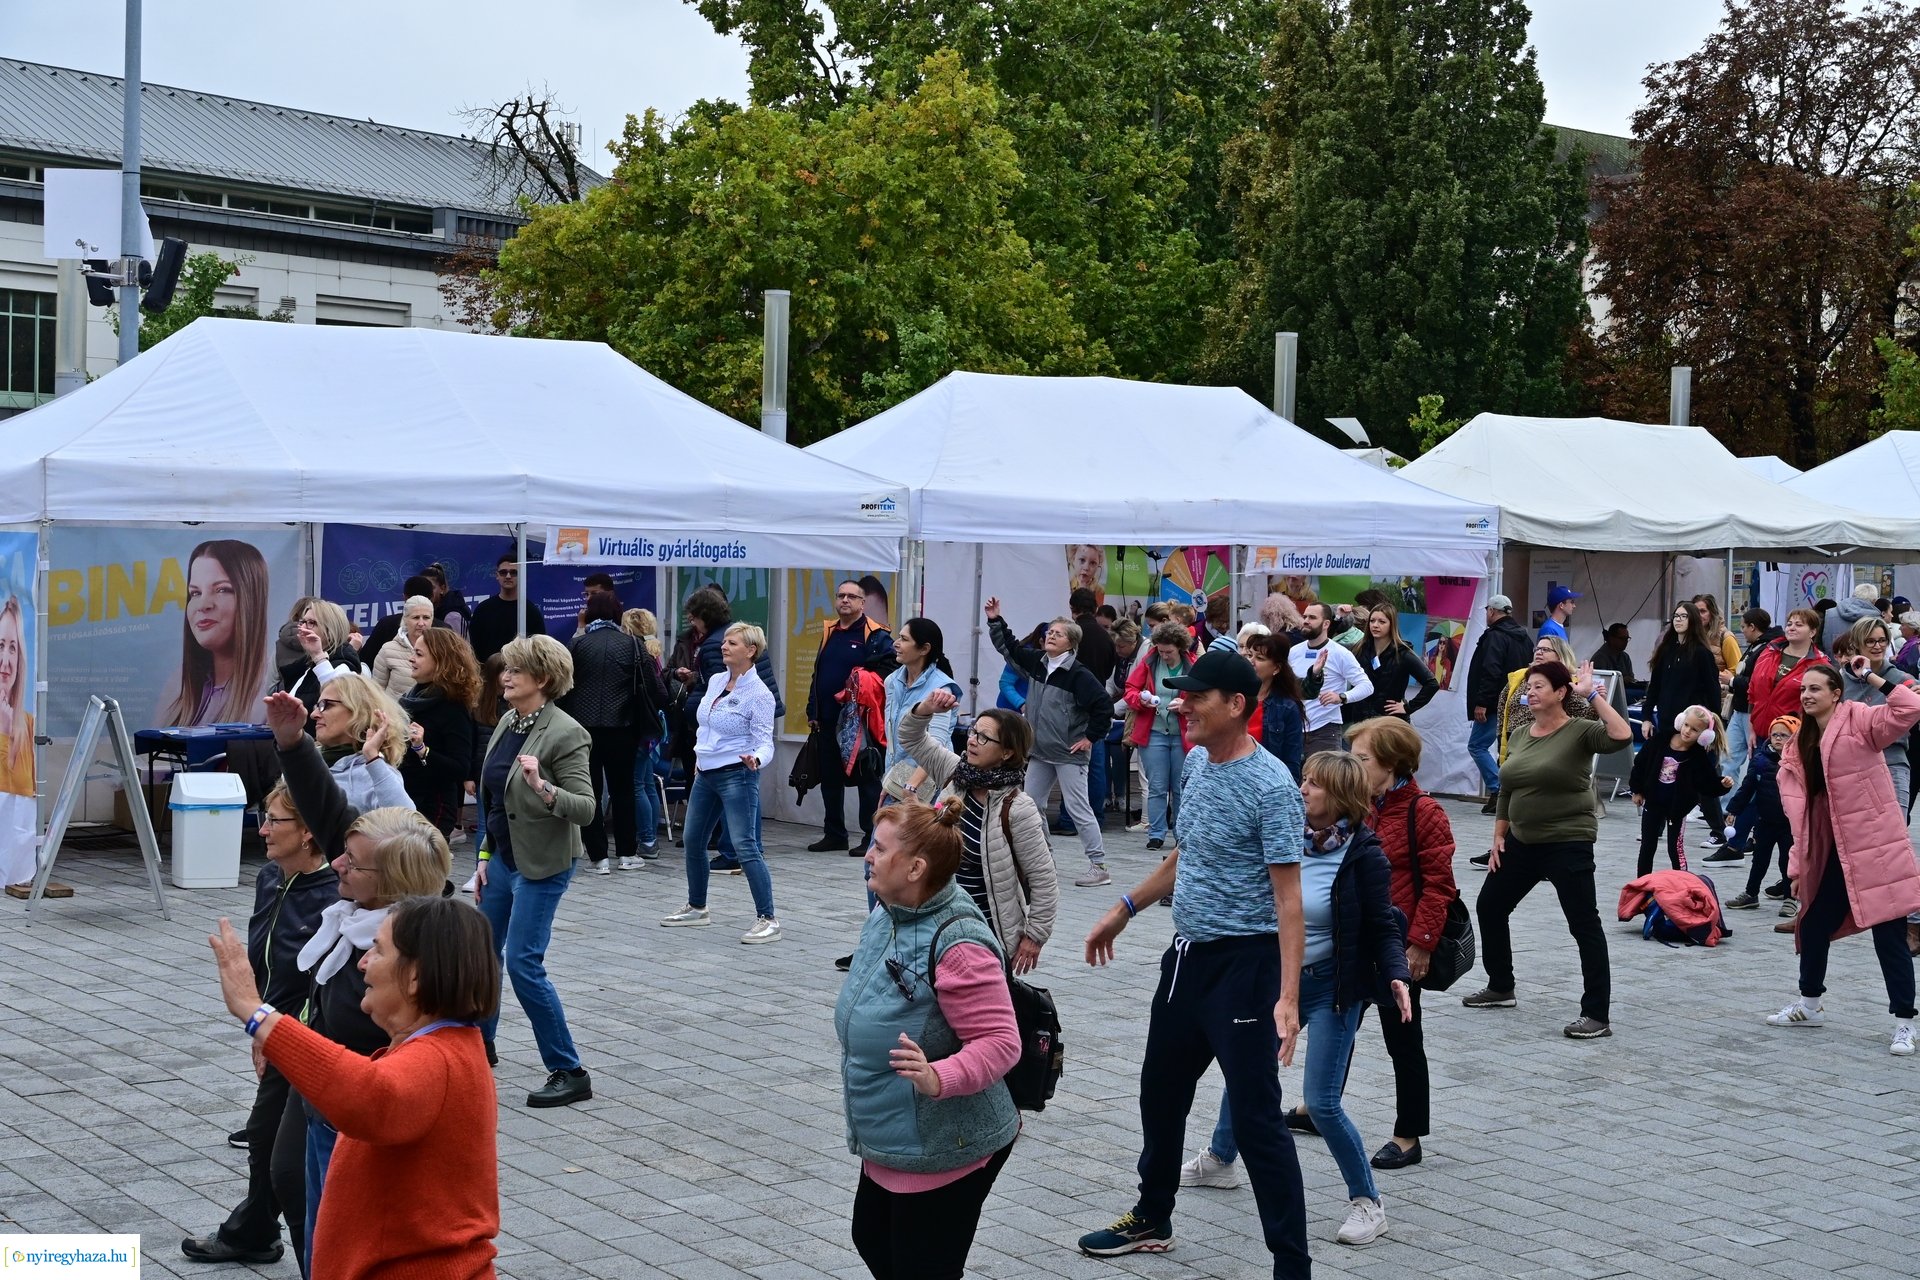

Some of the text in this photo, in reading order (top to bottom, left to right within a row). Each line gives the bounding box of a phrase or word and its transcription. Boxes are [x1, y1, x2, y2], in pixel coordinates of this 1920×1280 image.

[599, 537, 747, 562] Virtuális gyárlátogatás
[1282, 553, 1371, 572] Lifestyle Boulevard
